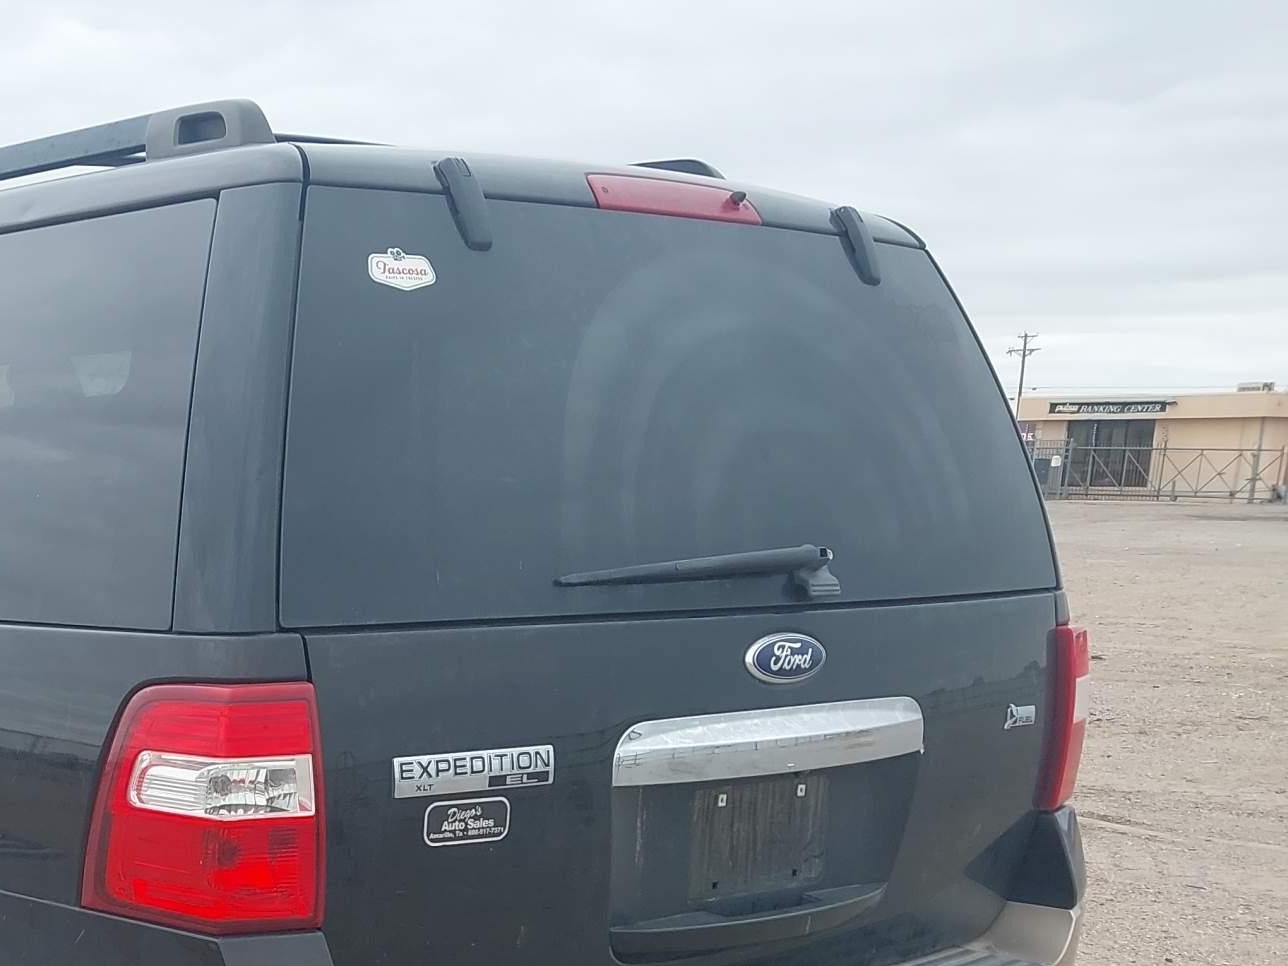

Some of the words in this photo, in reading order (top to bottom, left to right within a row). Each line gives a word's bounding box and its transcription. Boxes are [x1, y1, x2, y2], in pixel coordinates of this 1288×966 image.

[375, 260, 428, 276] Tascosa
[1124, 403, 1162, 413] CENTER
[770, 641, 812, 671] Ford
[399, 750, 551, 780] EXPEDITION
[506, 774, 538, 785] EL
[415, 783, 434, 792] XLT
[447, 805, 482, 822] Diego's
[441, 820, 465, 832] Auto
[466, 817, 495, 829] Sales
